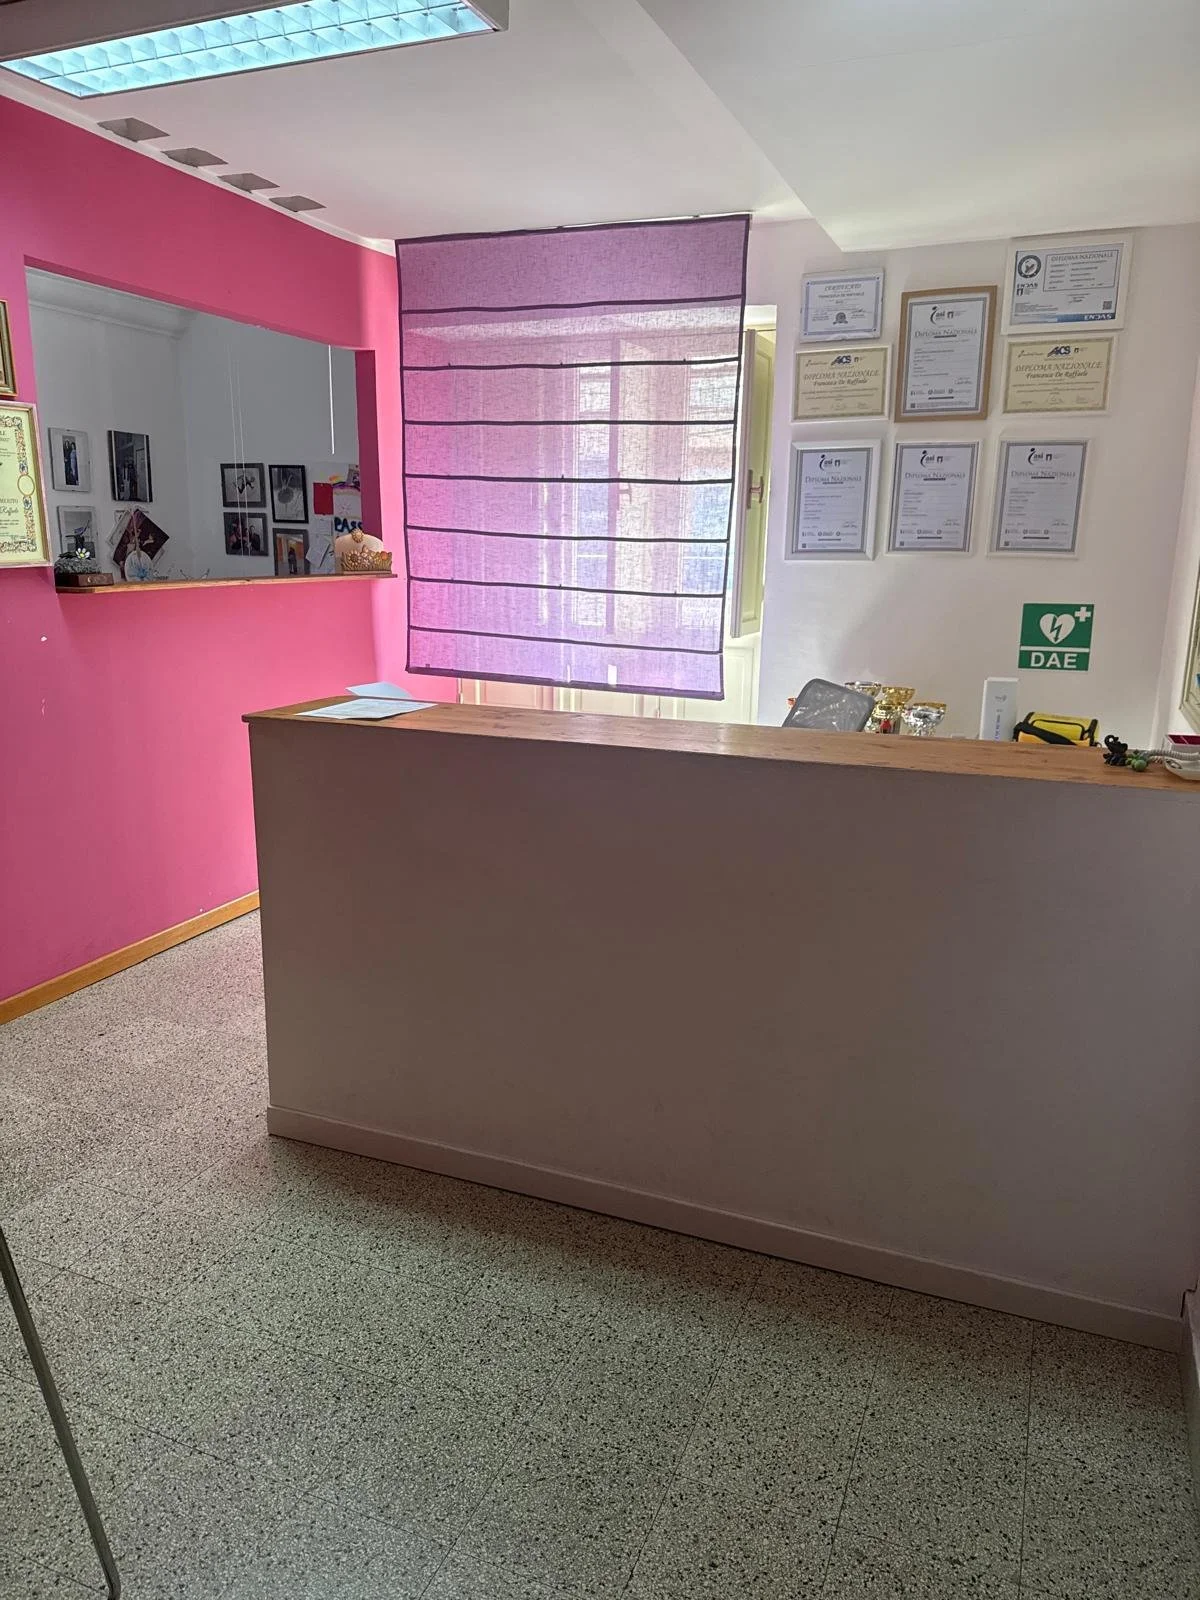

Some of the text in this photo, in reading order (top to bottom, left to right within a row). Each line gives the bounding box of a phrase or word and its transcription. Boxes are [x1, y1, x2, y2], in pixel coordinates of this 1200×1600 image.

[1047, 346, 1071, 357] ACS
[831, 355, 852, 366] ACS
[1030, 652, 1078, 669] DAE
